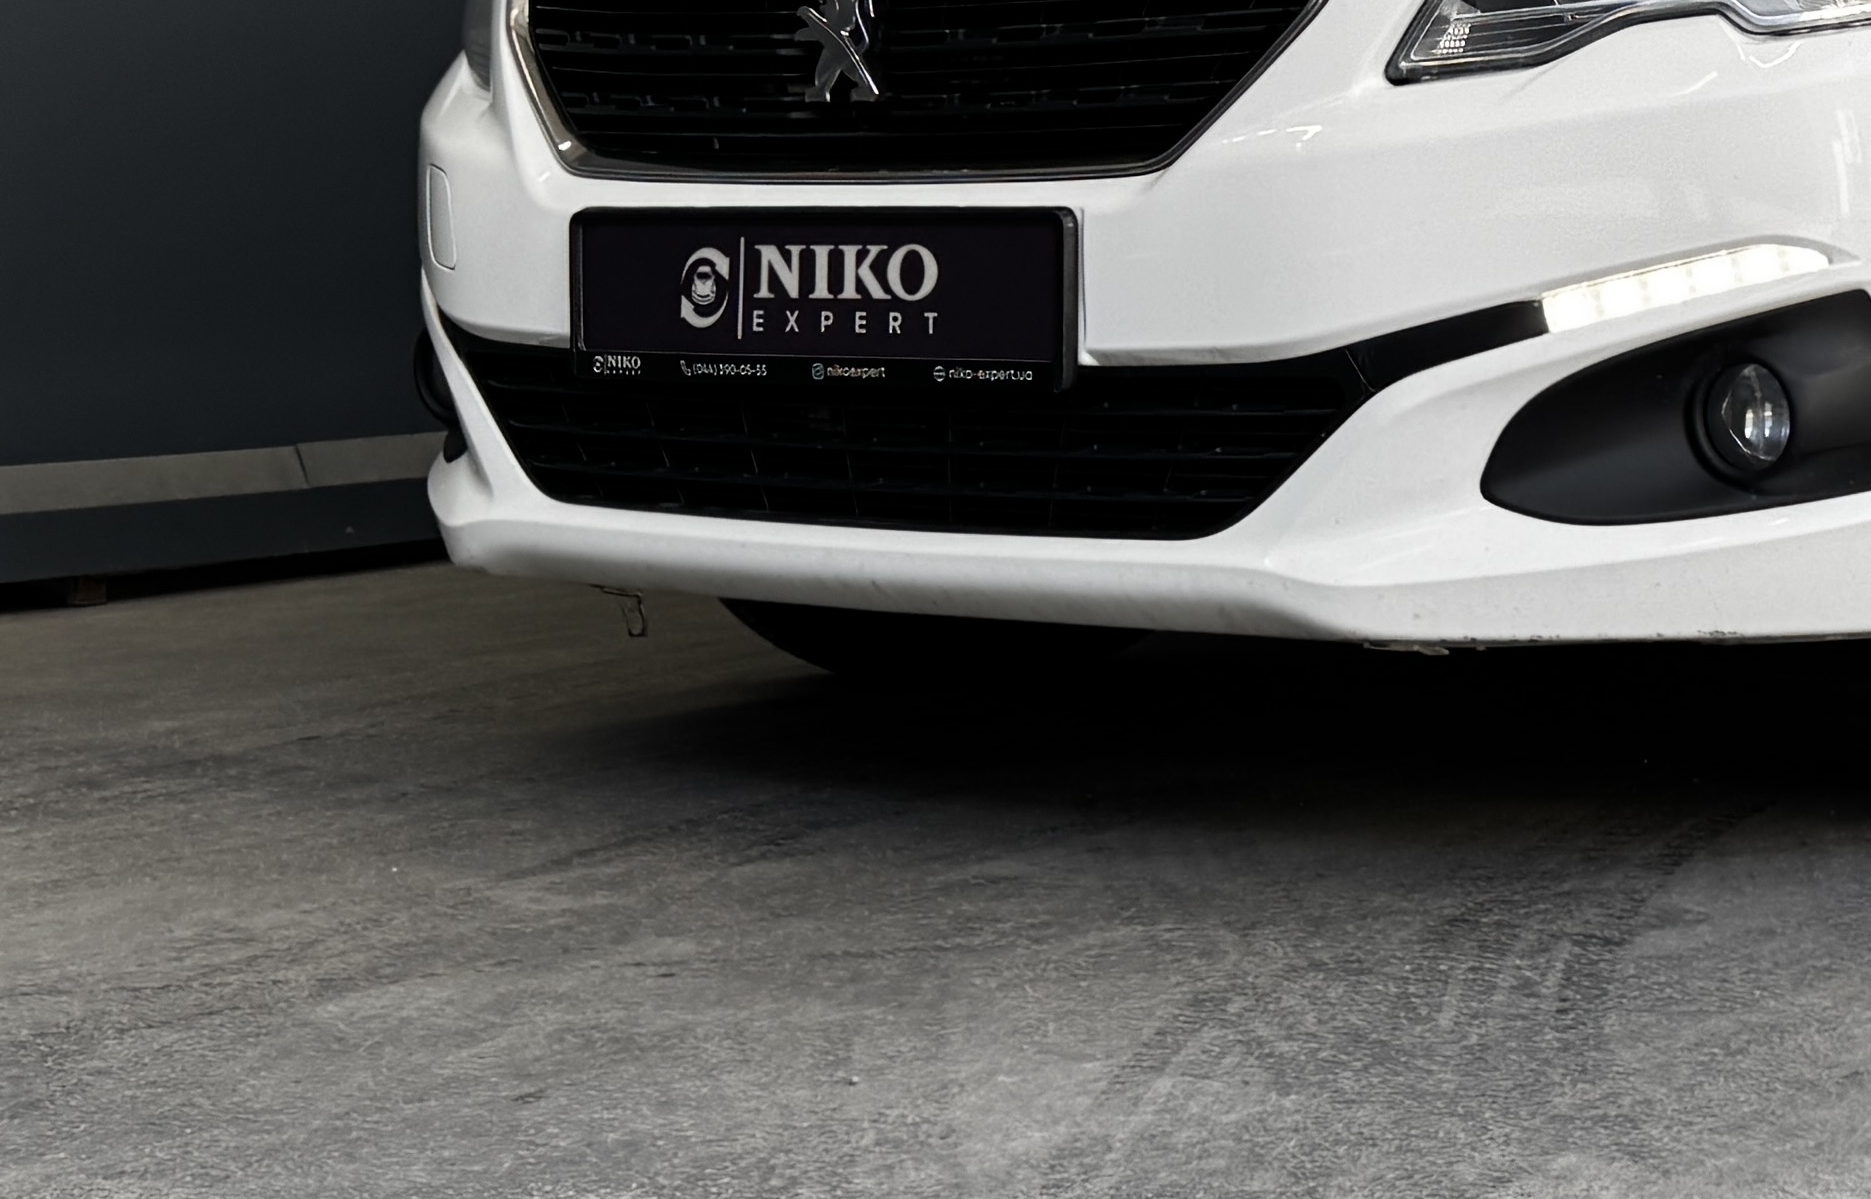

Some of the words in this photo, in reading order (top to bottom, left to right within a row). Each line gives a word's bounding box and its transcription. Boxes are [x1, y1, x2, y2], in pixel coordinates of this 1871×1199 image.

[753, 243, 940, 302] NIKO
[752, 309, 939, 335] EXPERT
[607, 355, 641, 370] NIKO
